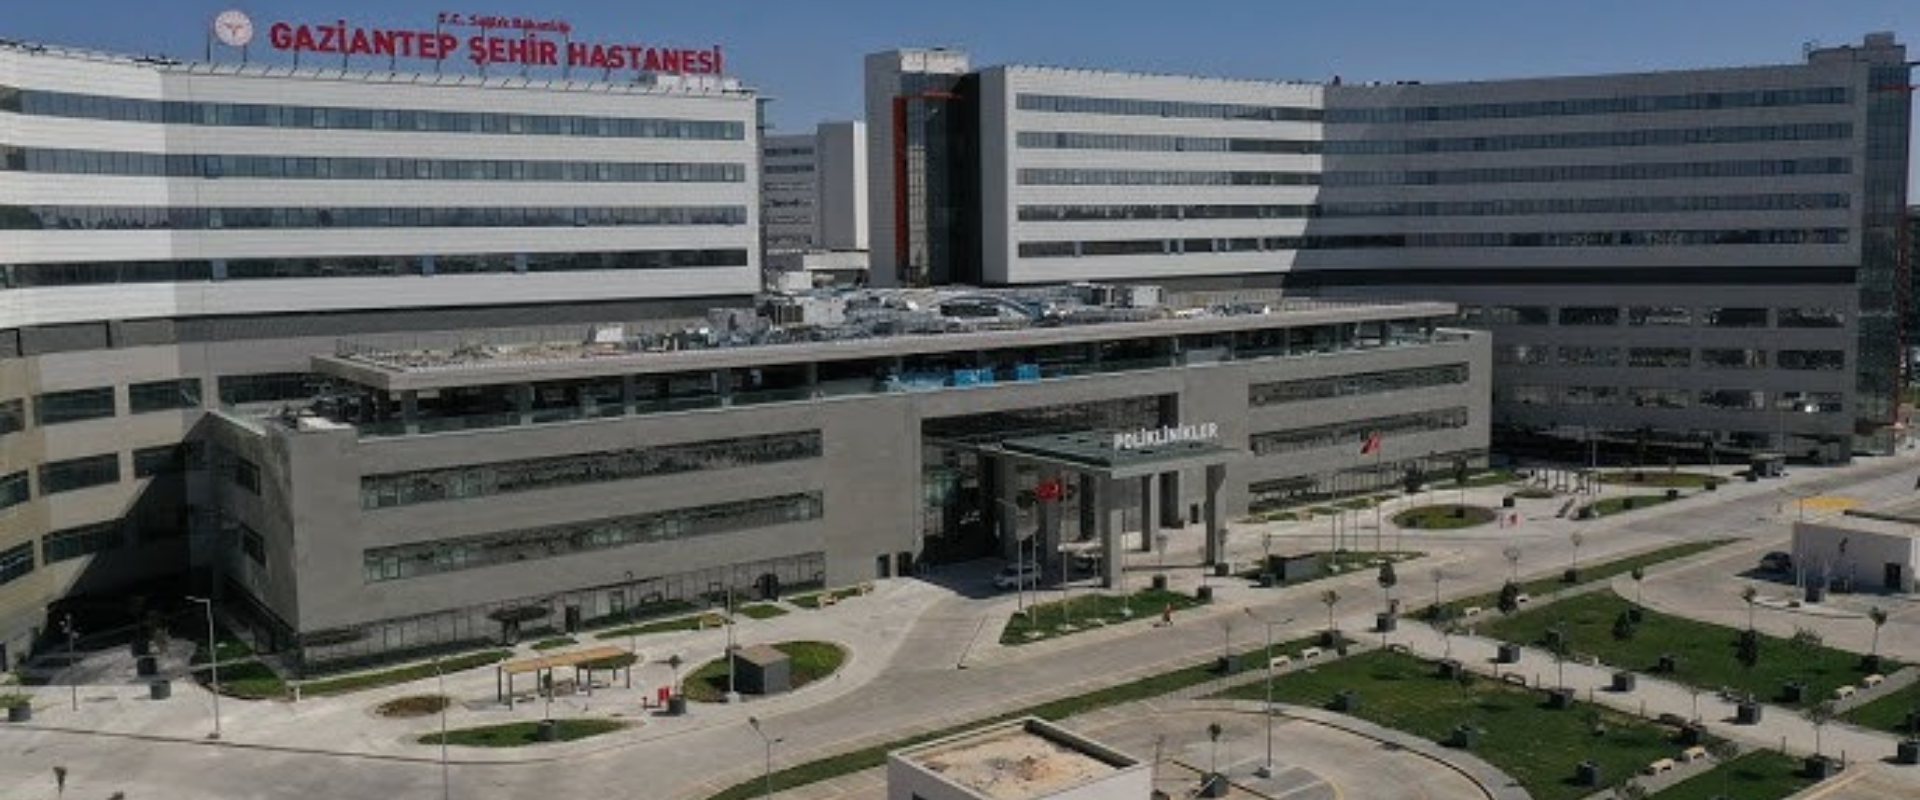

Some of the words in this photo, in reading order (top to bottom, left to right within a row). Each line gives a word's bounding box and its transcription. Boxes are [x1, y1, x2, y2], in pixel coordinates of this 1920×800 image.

[269, 20, 458, 60] GAZİANTEP
[468, 33, 558, 65] ŞEHİR
[567, 42, 722, 75] HASTANESİ
[1113, 422, 1218, 450] POLİKLİNİKLER
